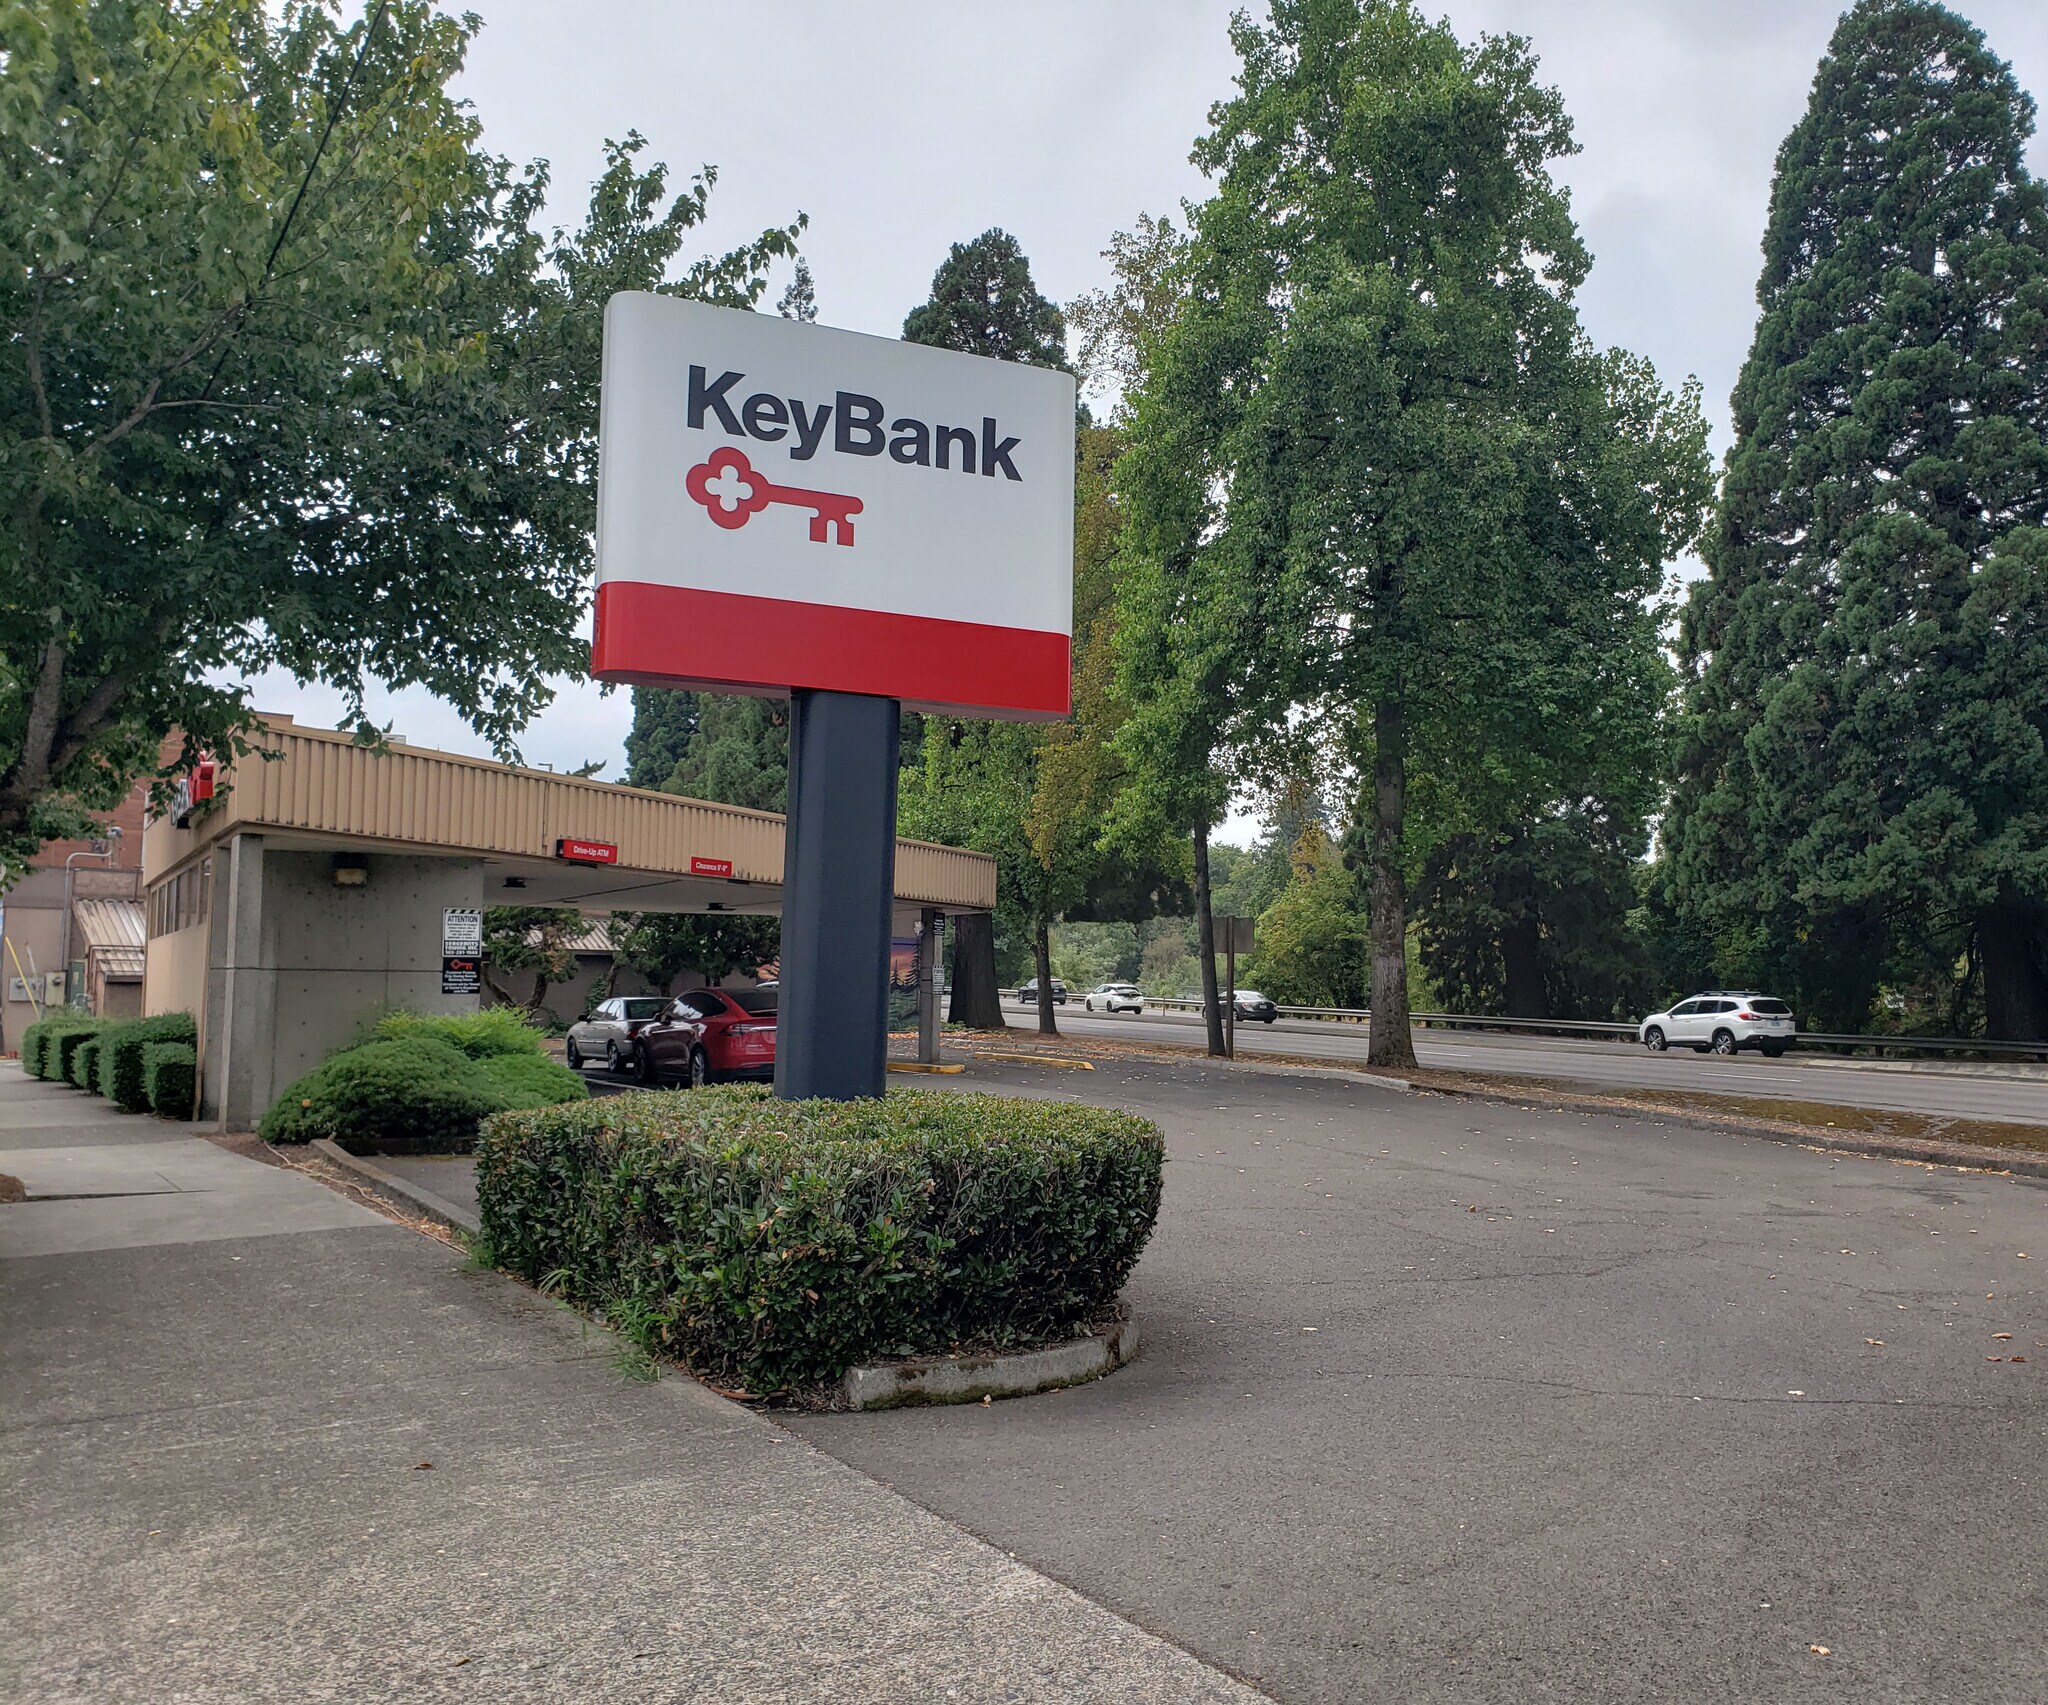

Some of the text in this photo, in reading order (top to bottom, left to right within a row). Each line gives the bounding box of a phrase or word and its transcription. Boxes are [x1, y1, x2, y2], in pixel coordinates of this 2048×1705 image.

[687, 364, 1023, 482] KeyBank
[573, 845, 609, 858] Drive-Up ATM
